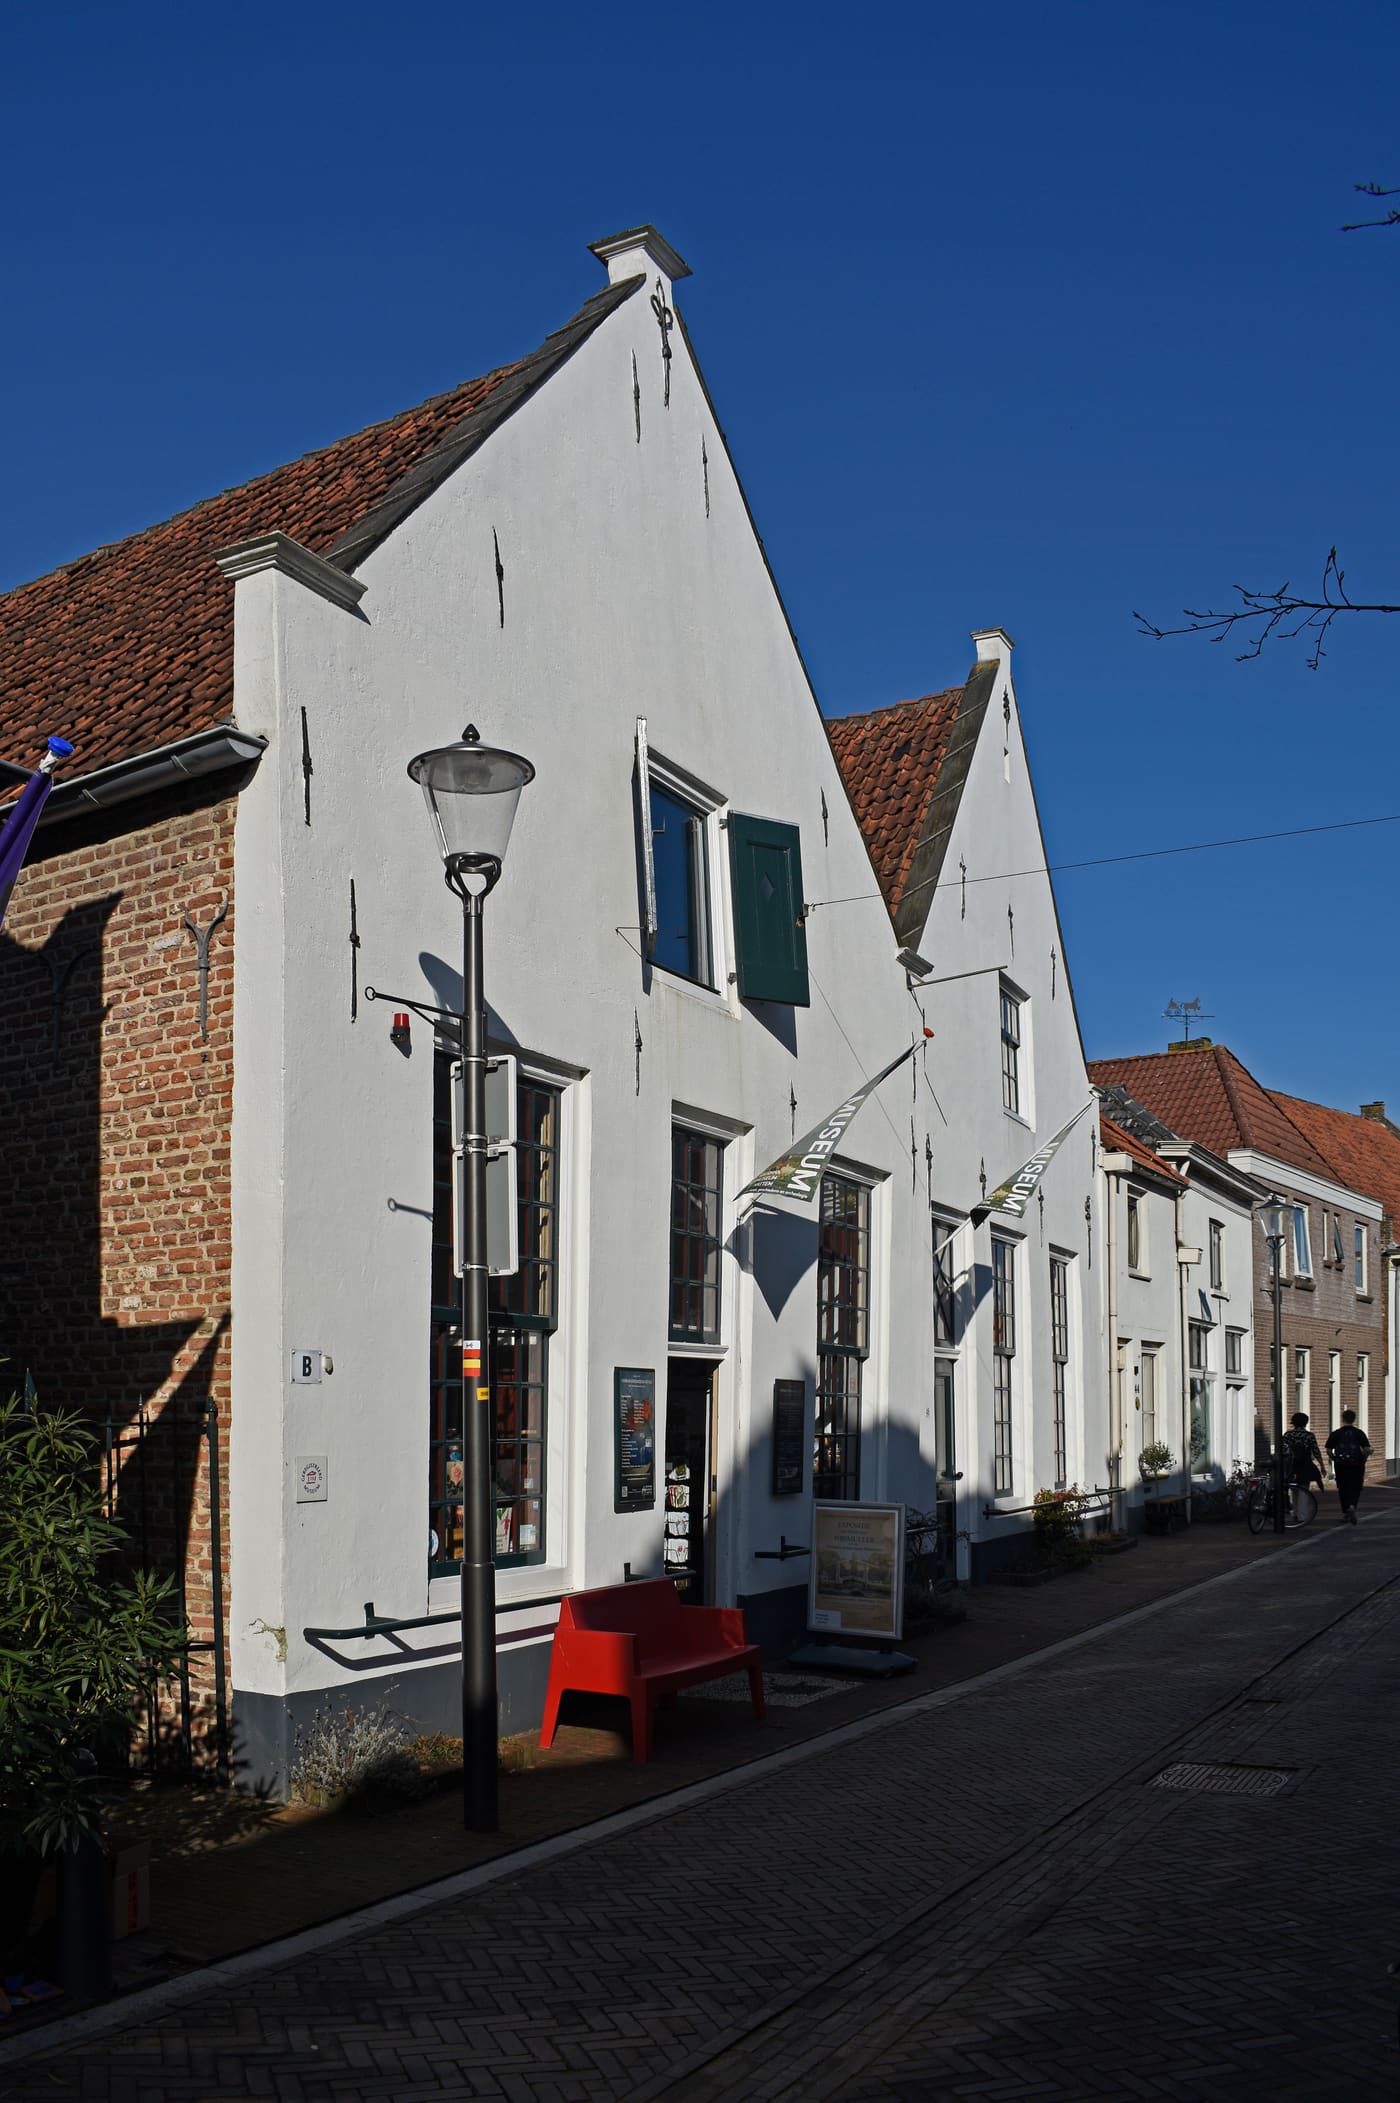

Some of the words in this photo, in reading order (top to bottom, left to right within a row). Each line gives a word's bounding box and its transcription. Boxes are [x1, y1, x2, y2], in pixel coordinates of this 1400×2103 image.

[787, 1094, 866, 1192] MUSEUM
[1002, 1142, 1060, 1211] MUSEUM
[302, 1355, 312, 1377] B
